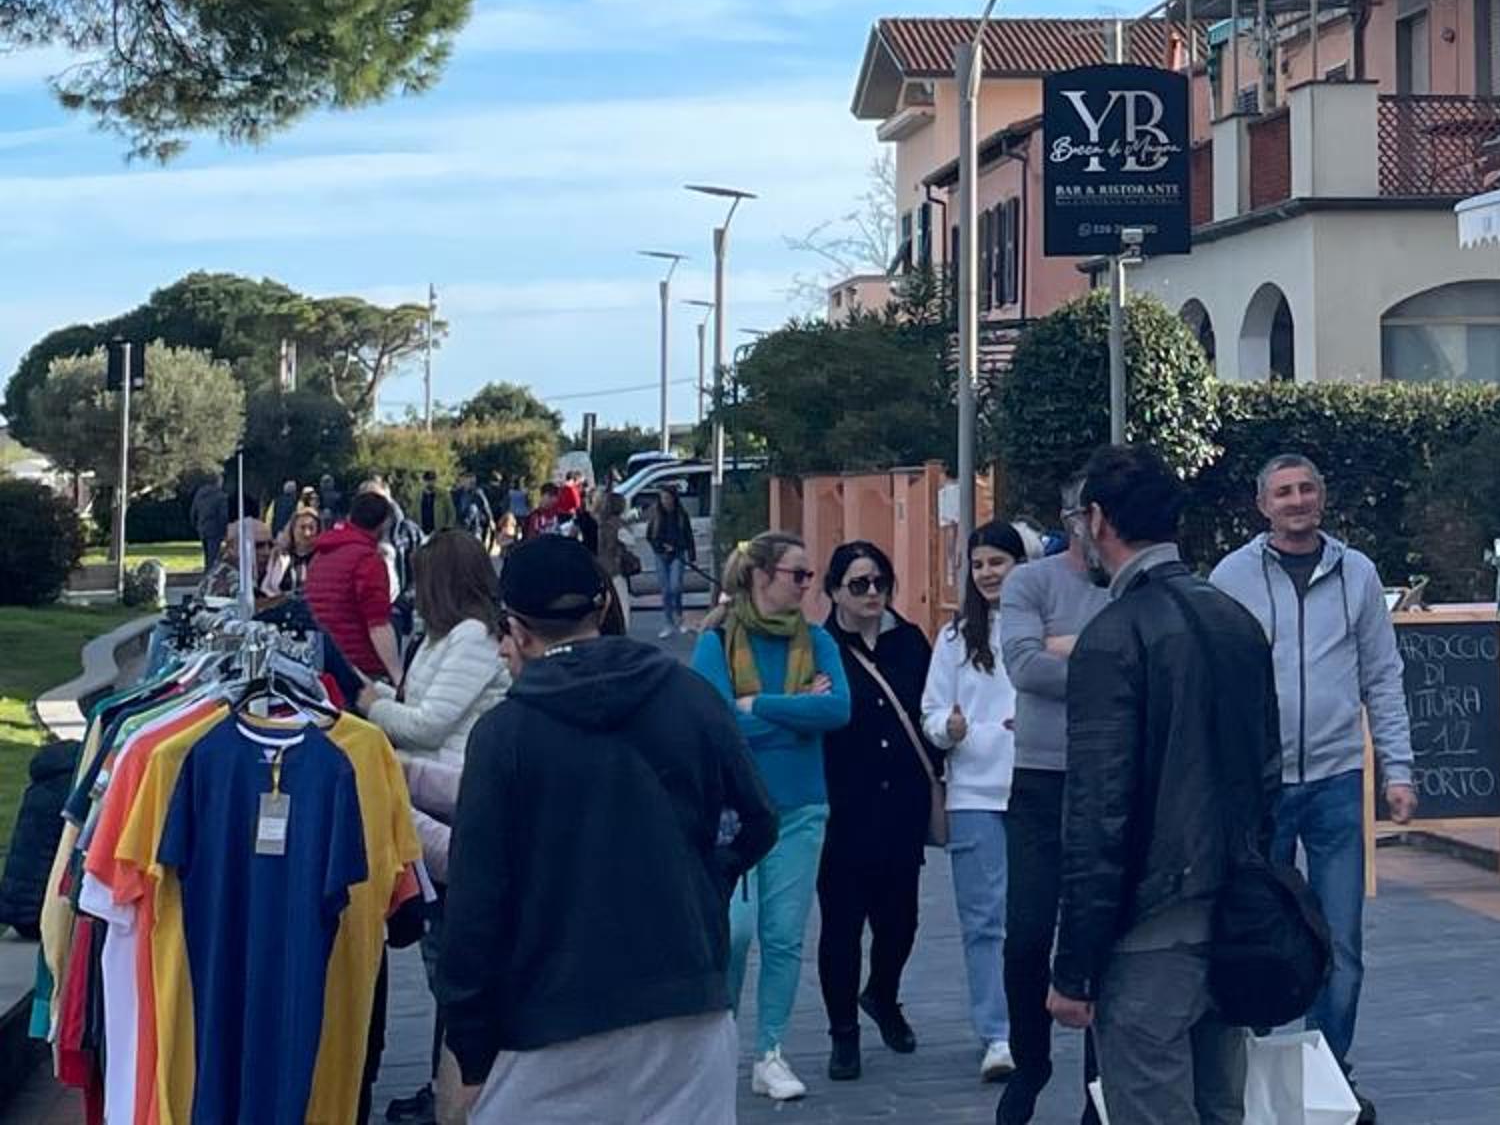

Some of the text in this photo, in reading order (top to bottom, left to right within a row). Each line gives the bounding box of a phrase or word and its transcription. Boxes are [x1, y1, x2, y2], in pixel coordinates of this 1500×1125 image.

[1056, 184, 1081, 196] BAR
[1099, 183, 1179, 195] RISTORANTE
[1399, 632, 1500, 660] ARTOCCIO
[1423, 662, 1445, 686] DI
[1408, 685, 1480, 716] ITTURA
